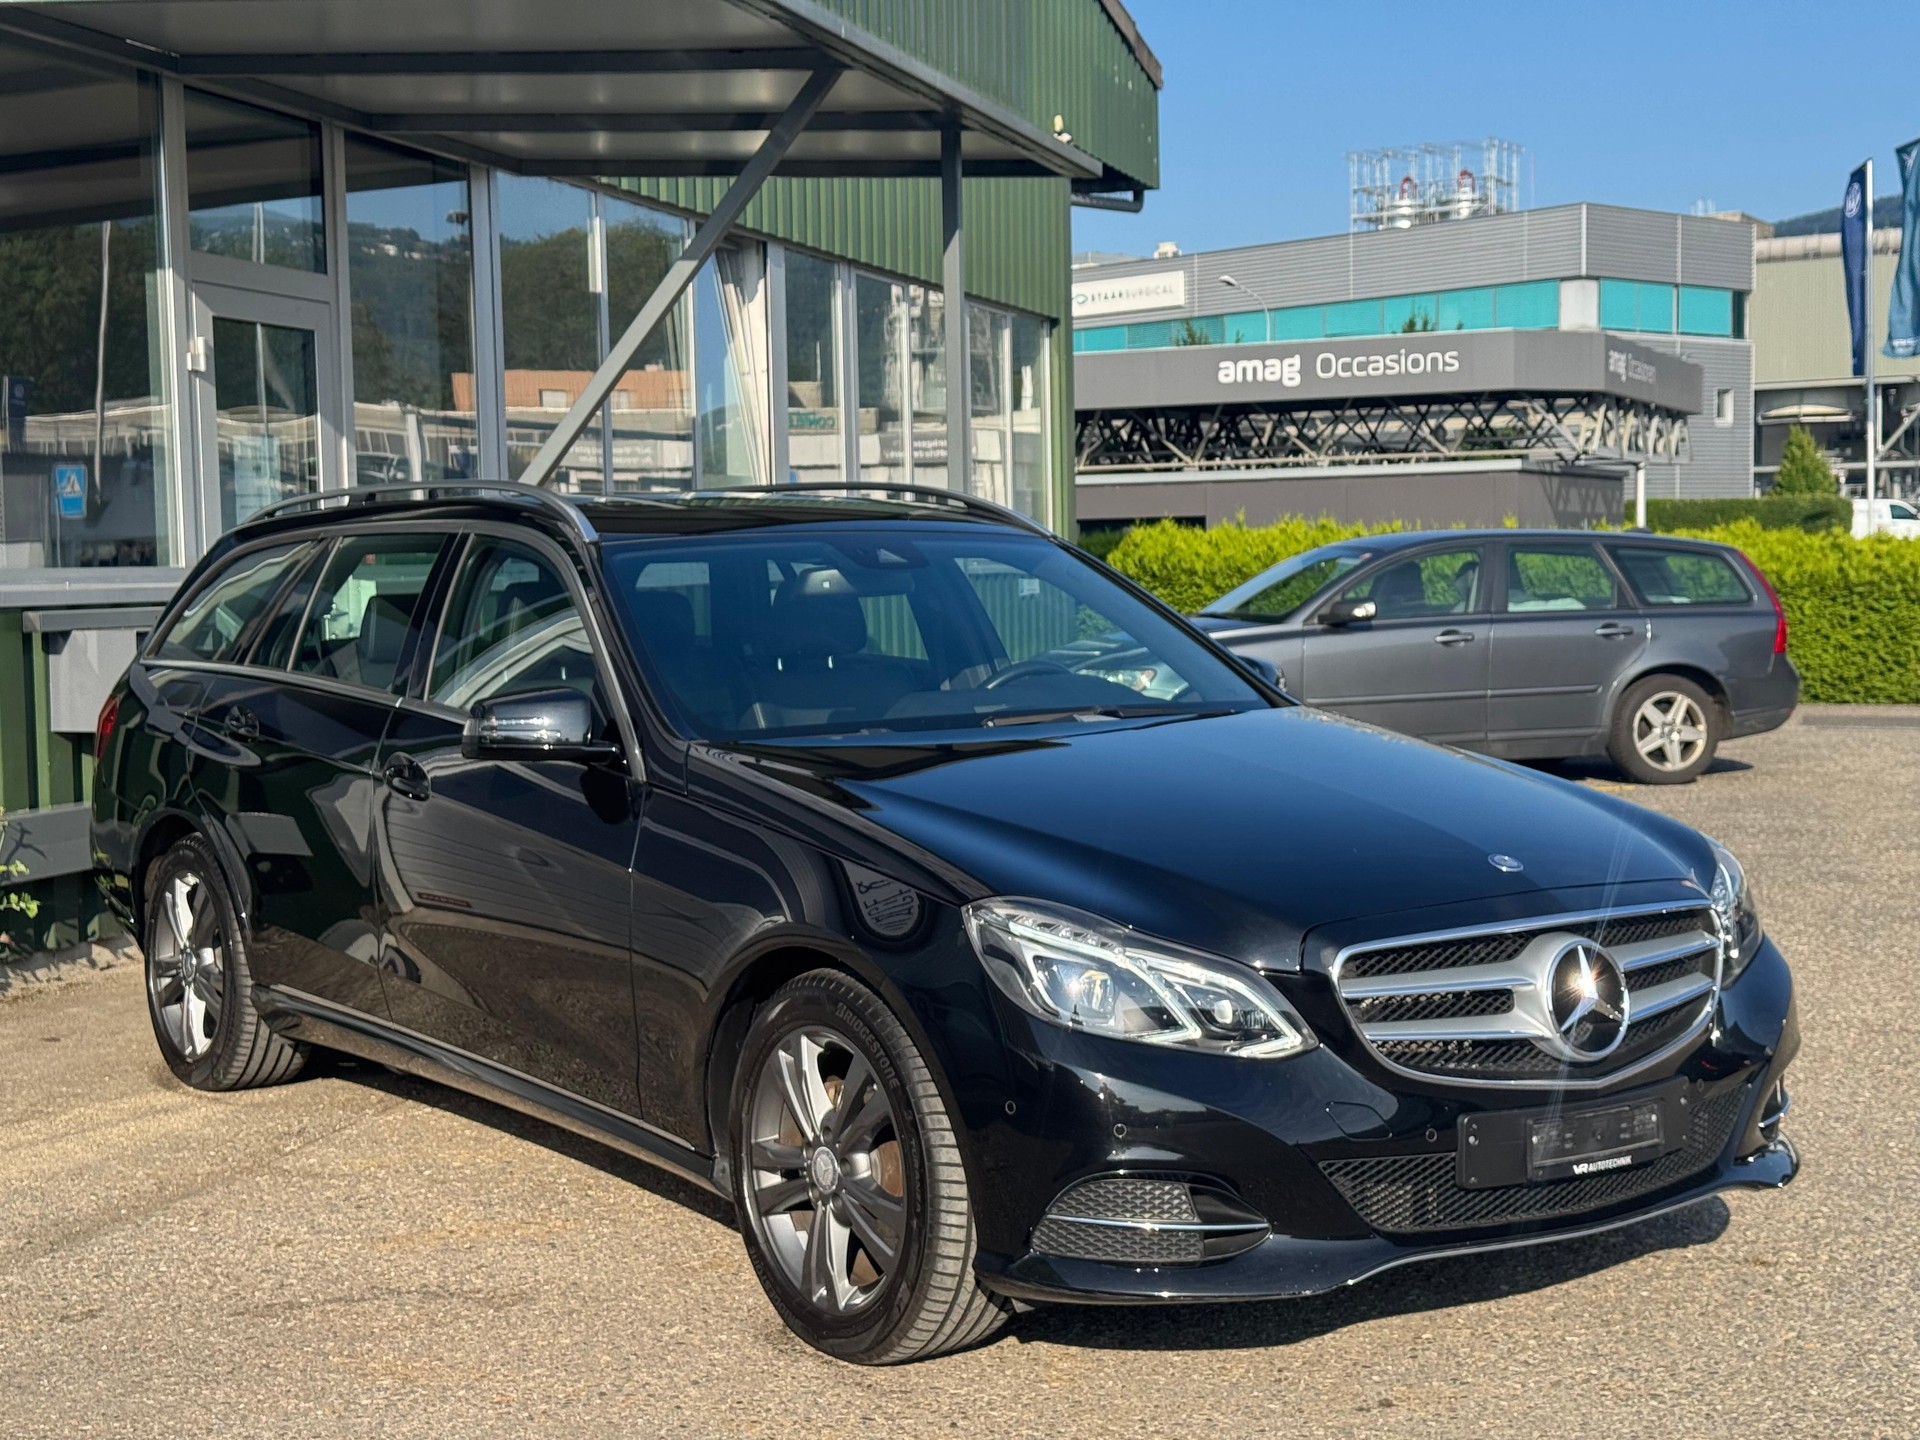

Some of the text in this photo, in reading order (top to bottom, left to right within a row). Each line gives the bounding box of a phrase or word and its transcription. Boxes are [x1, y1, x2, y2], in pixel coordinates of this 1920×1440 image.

[1217, 349, 1460, 387] amag Occasions
[835, 1002, 900, 1089] BRIDGESTONE
